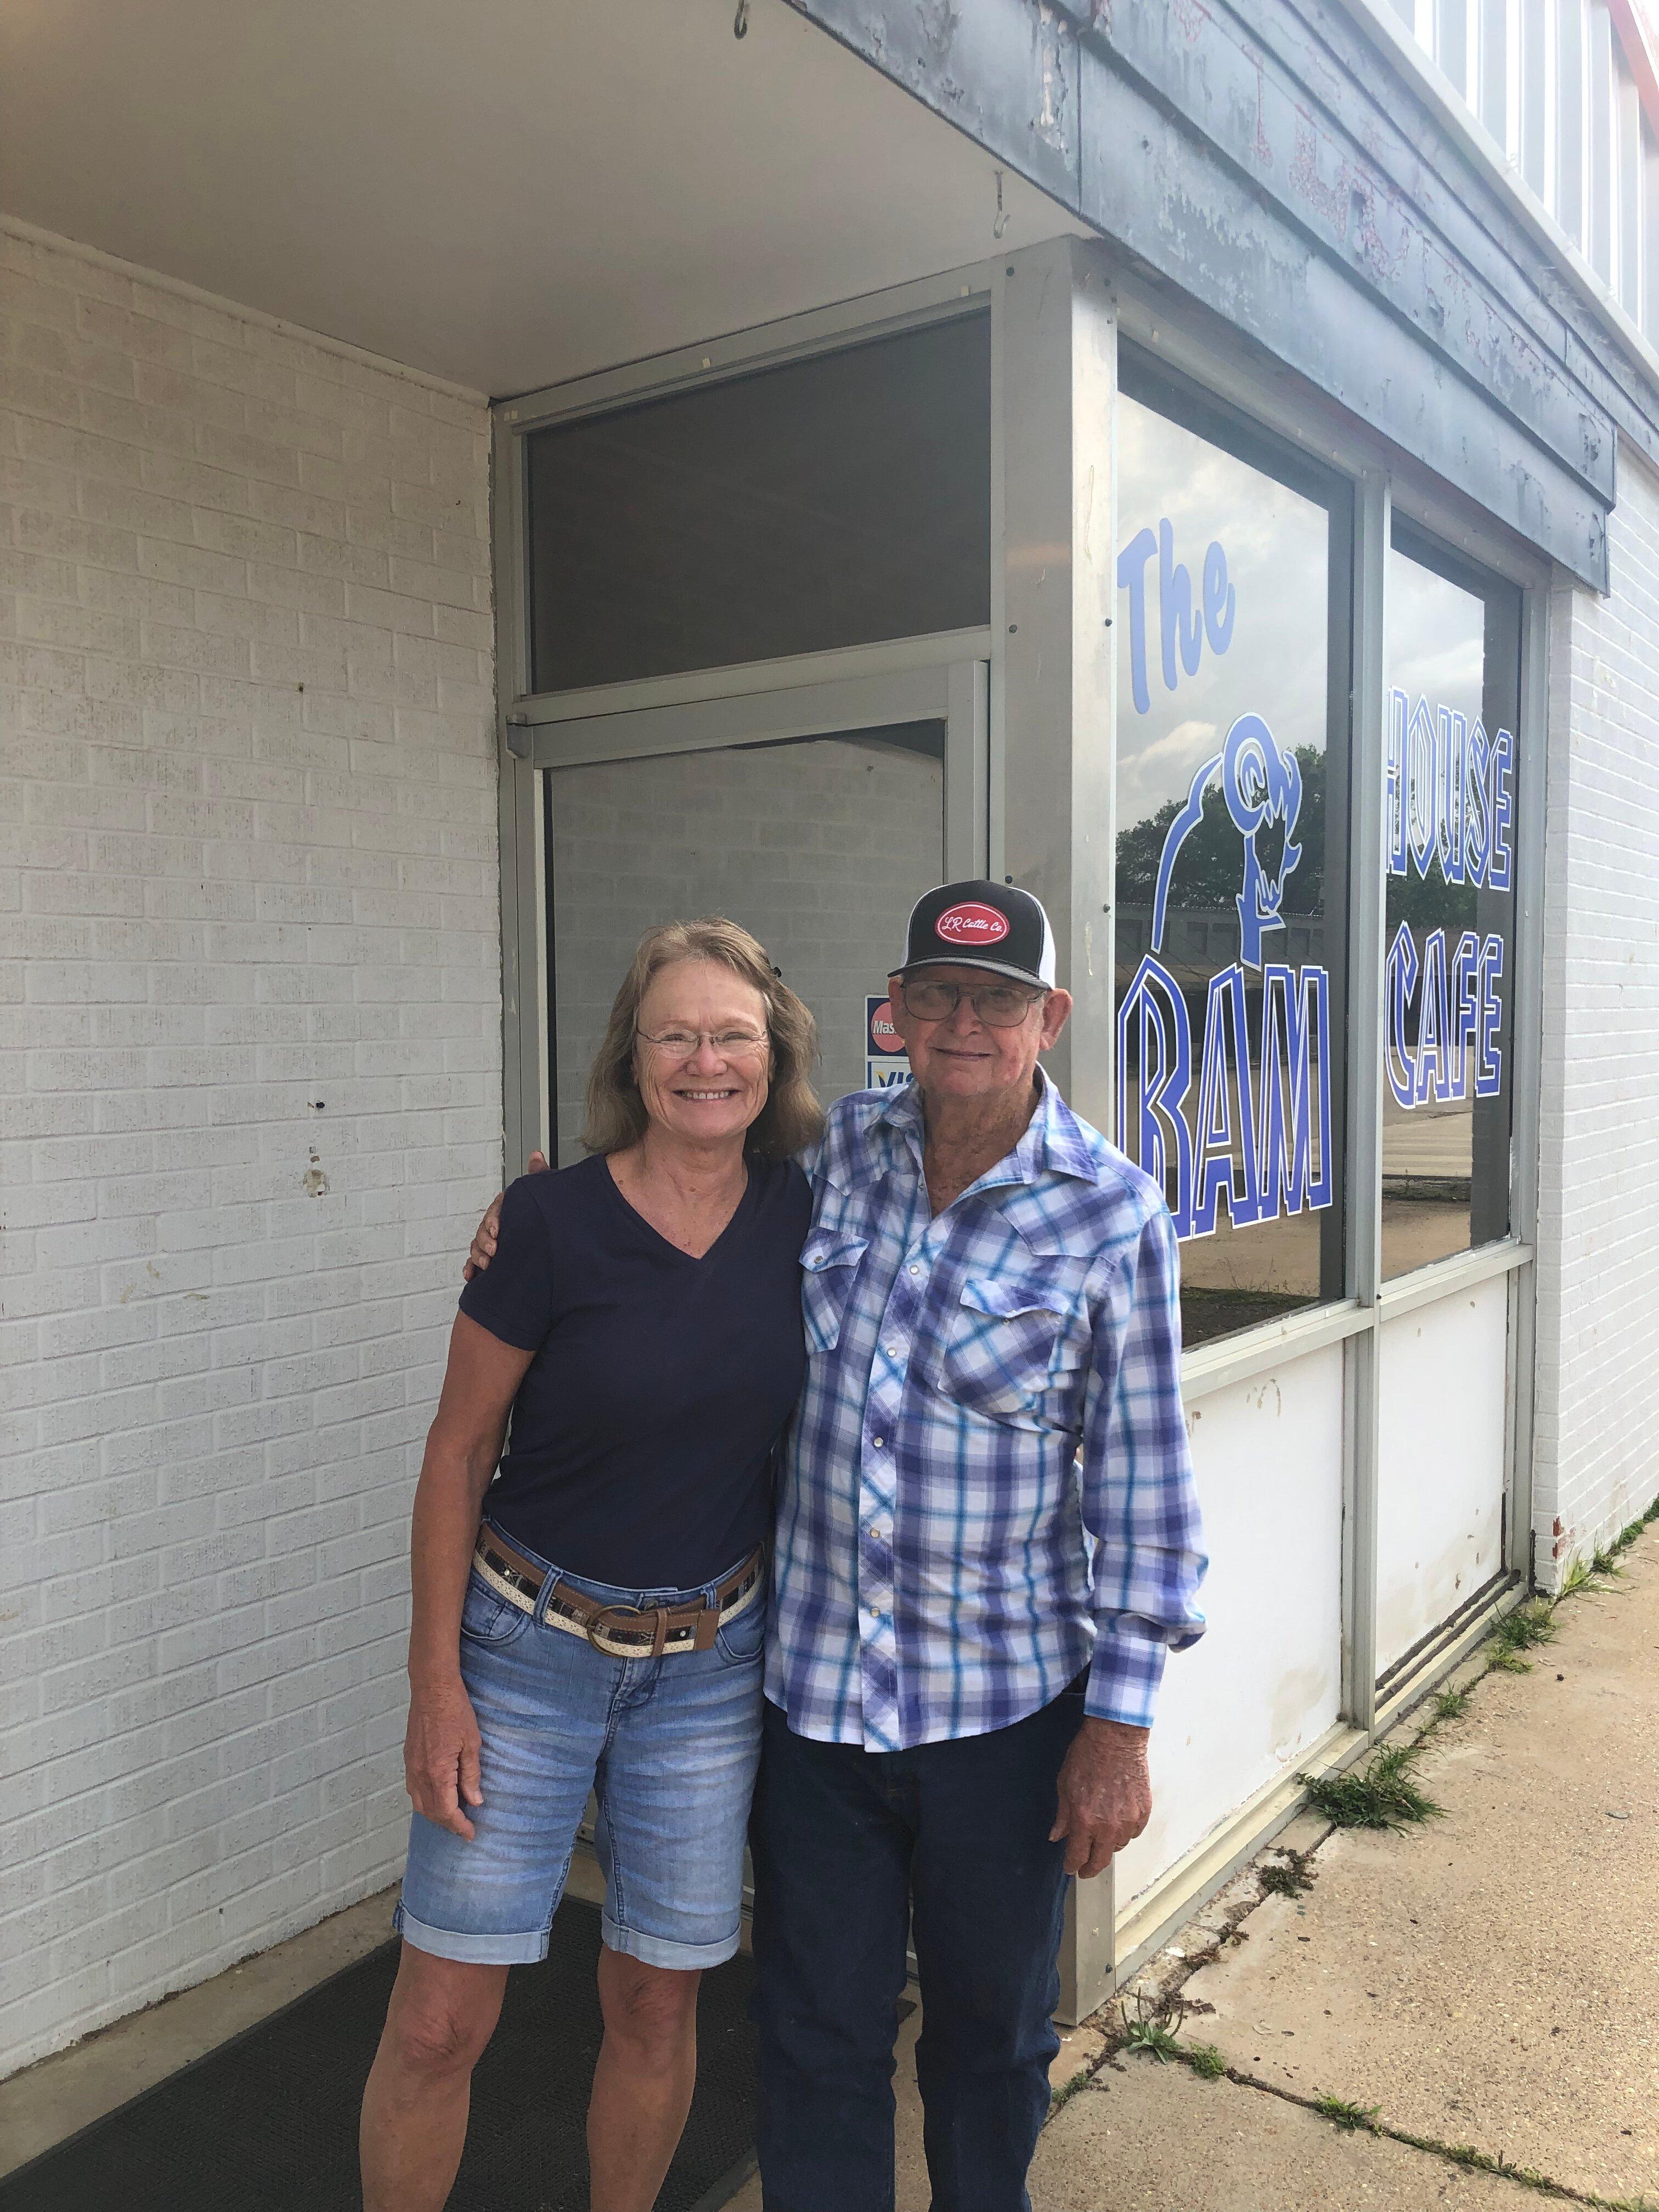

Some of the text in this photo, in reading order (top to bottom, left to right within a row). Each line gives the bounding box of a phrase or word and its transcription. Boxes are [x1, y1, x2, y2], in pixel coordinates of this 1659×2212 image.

[1117, 517, 1235, 715] The
[941, 916, 963, 932] LR
[962, 918, 989, 929] Cattle
[1385, 919, 1503, 1109] CAFE
[873, 1020, 897, 1035] Mas
[1117, 953, 1333, 1243] RAM
